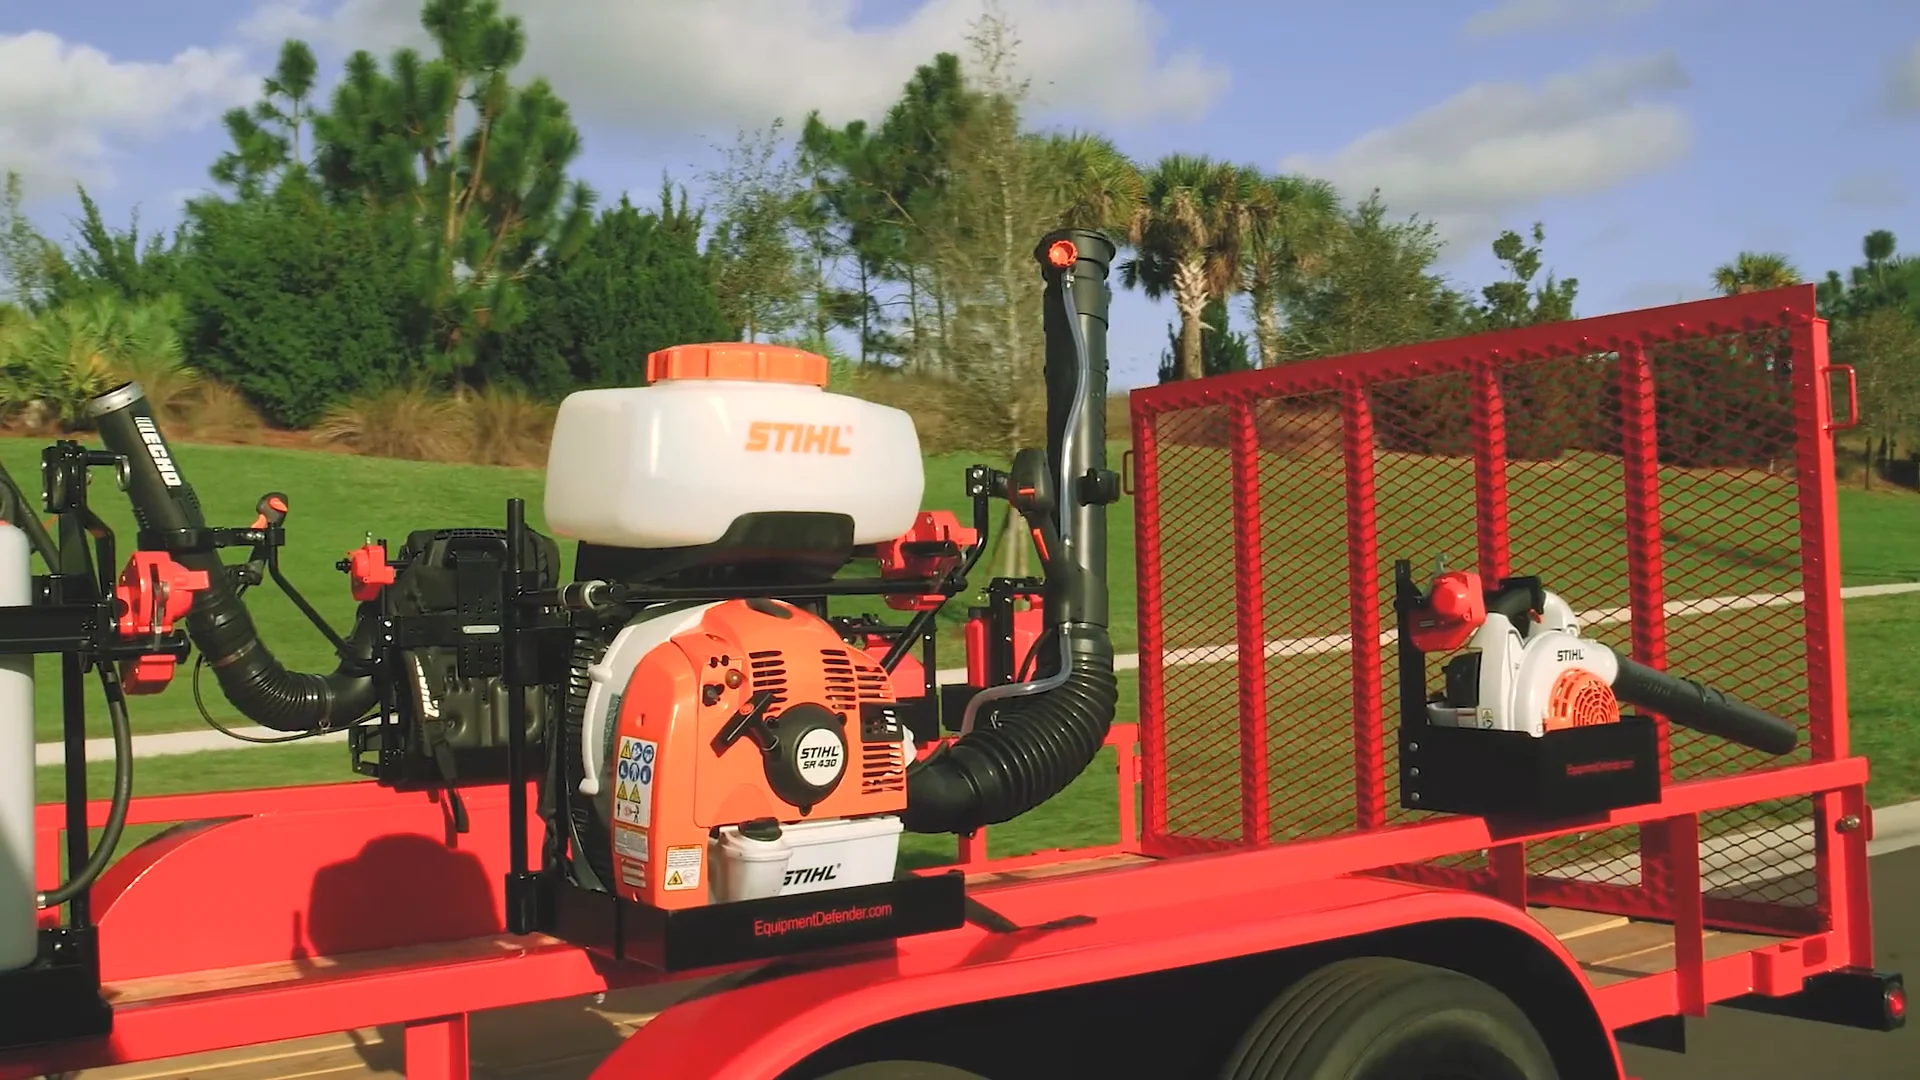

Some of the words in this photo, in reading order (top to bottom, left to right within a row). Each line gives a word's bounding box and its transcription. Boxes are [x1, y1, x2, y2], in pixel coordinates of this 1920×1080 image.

[745, 421, 852, 455] STIHL
[140, 431, 182, 487] ECHO
[1557, 649, 1584, 662] STIHL
[800, 746, 839, 759] STIHL
[803, 760, 817, 769] SR
[818, 759, 837, 768] 430
[754, 904, 892, 937] EquipmentDefender.com
